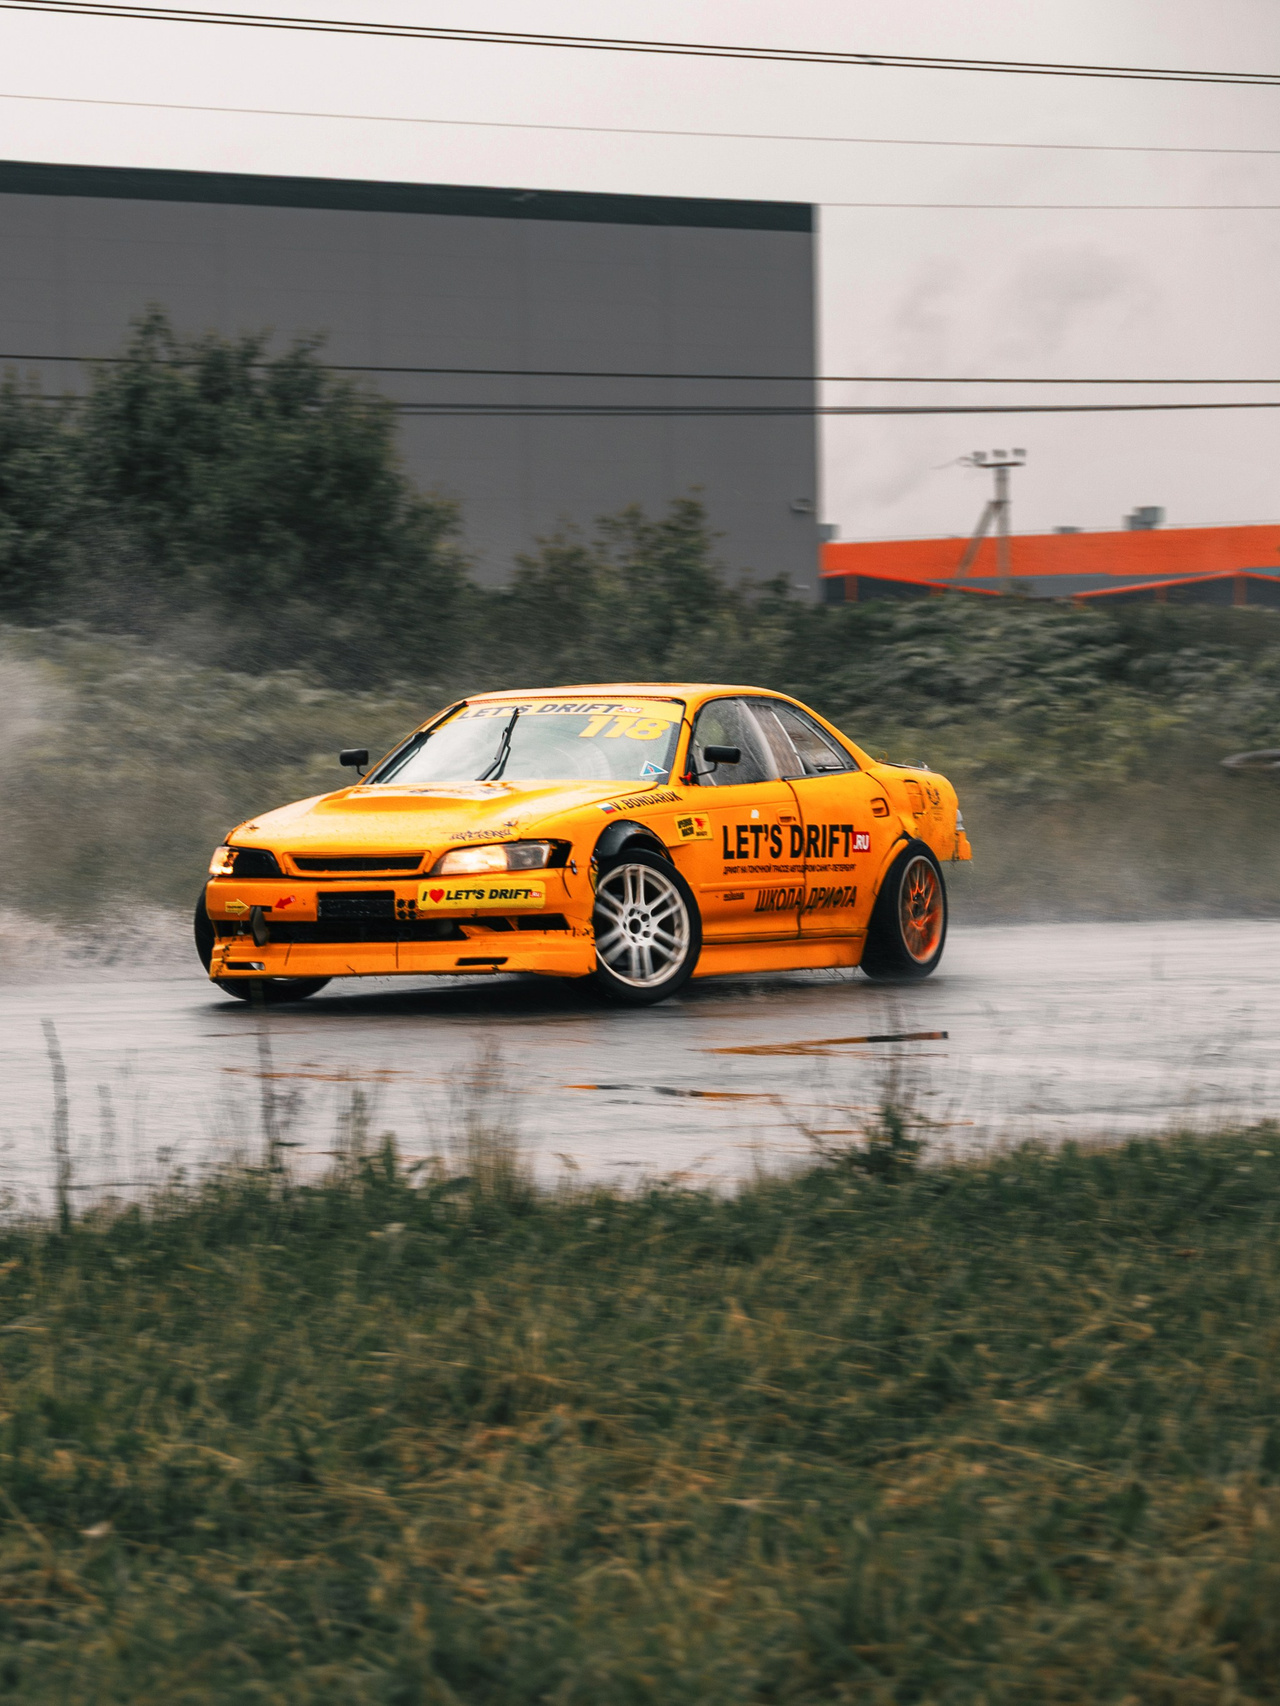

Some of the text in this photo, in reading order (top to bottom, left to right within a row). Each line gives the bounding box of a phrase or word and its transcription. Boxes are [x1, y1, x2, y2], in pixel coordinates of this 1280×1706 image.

[579, 715, 670, 740] 118
[621, 791, 683, 809] BONDARUK
[722, 824, 783, 859] LET'S
[446, 889, 485, 900] LET'S
[754, 886, 857, 914] ШКОЛА ДРИФТА
